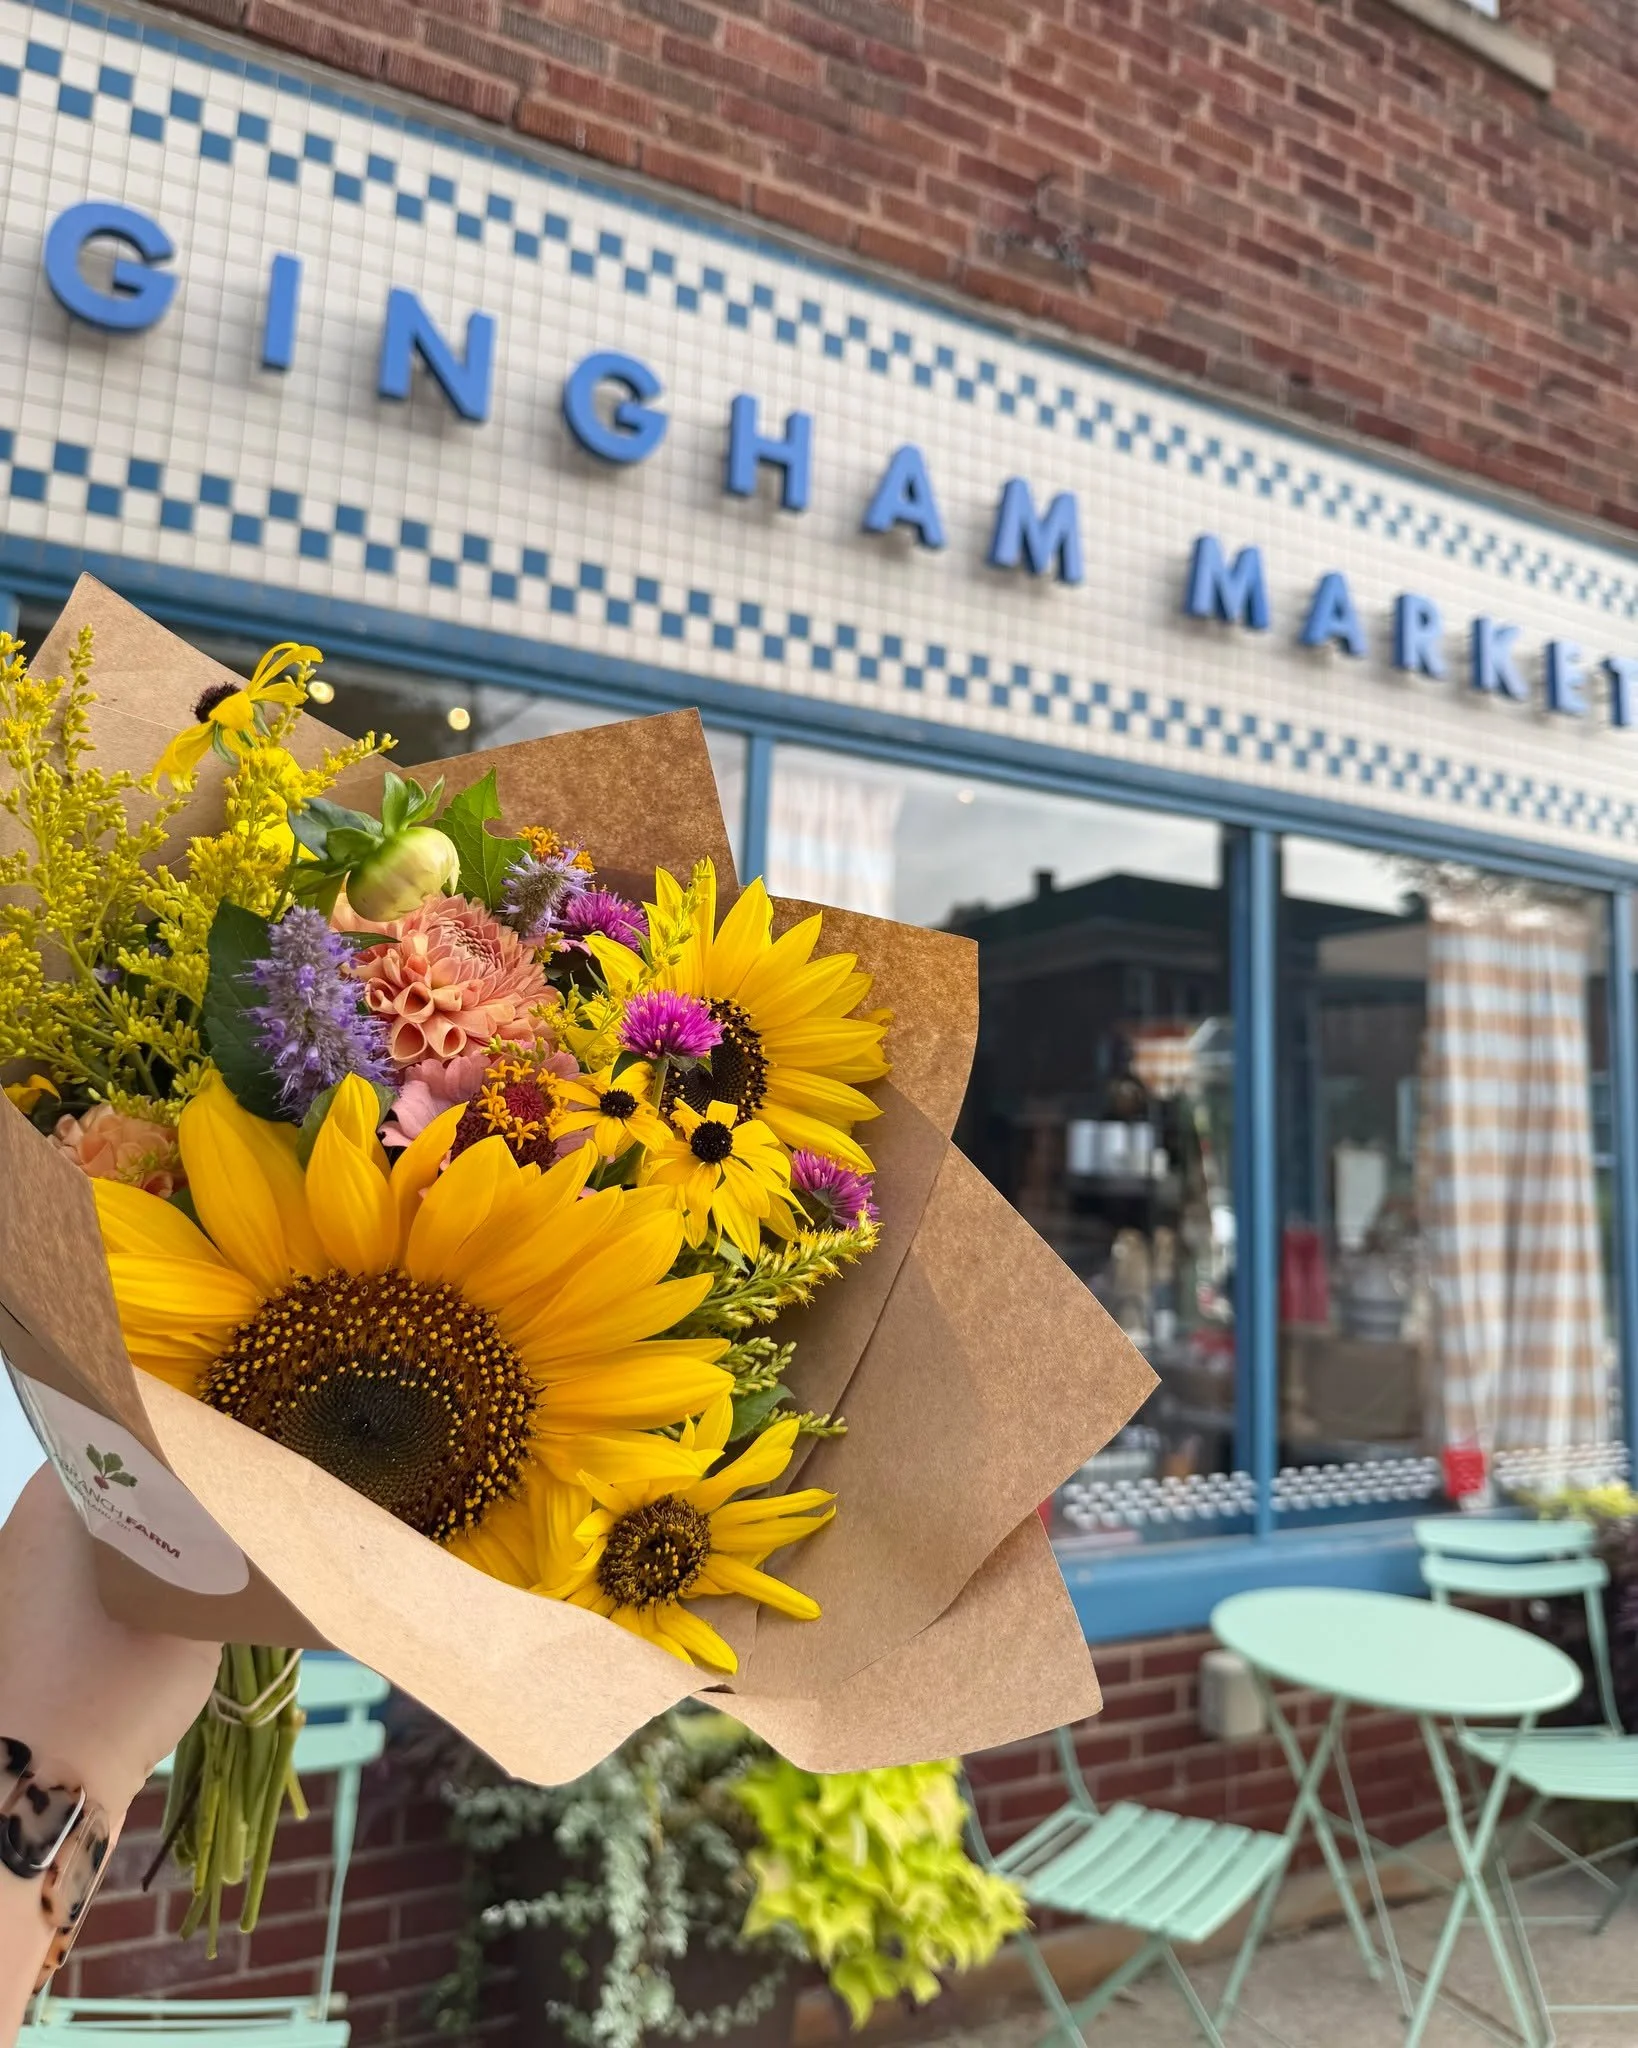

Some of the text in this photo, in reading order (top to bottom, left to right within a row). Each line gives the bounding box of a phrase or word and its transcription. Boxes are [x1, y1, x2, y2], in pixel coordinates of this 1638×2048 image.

[43, 200, 1638, 728] GINGHAM MARKET
[126, 1515, 181, 1559] FARM
